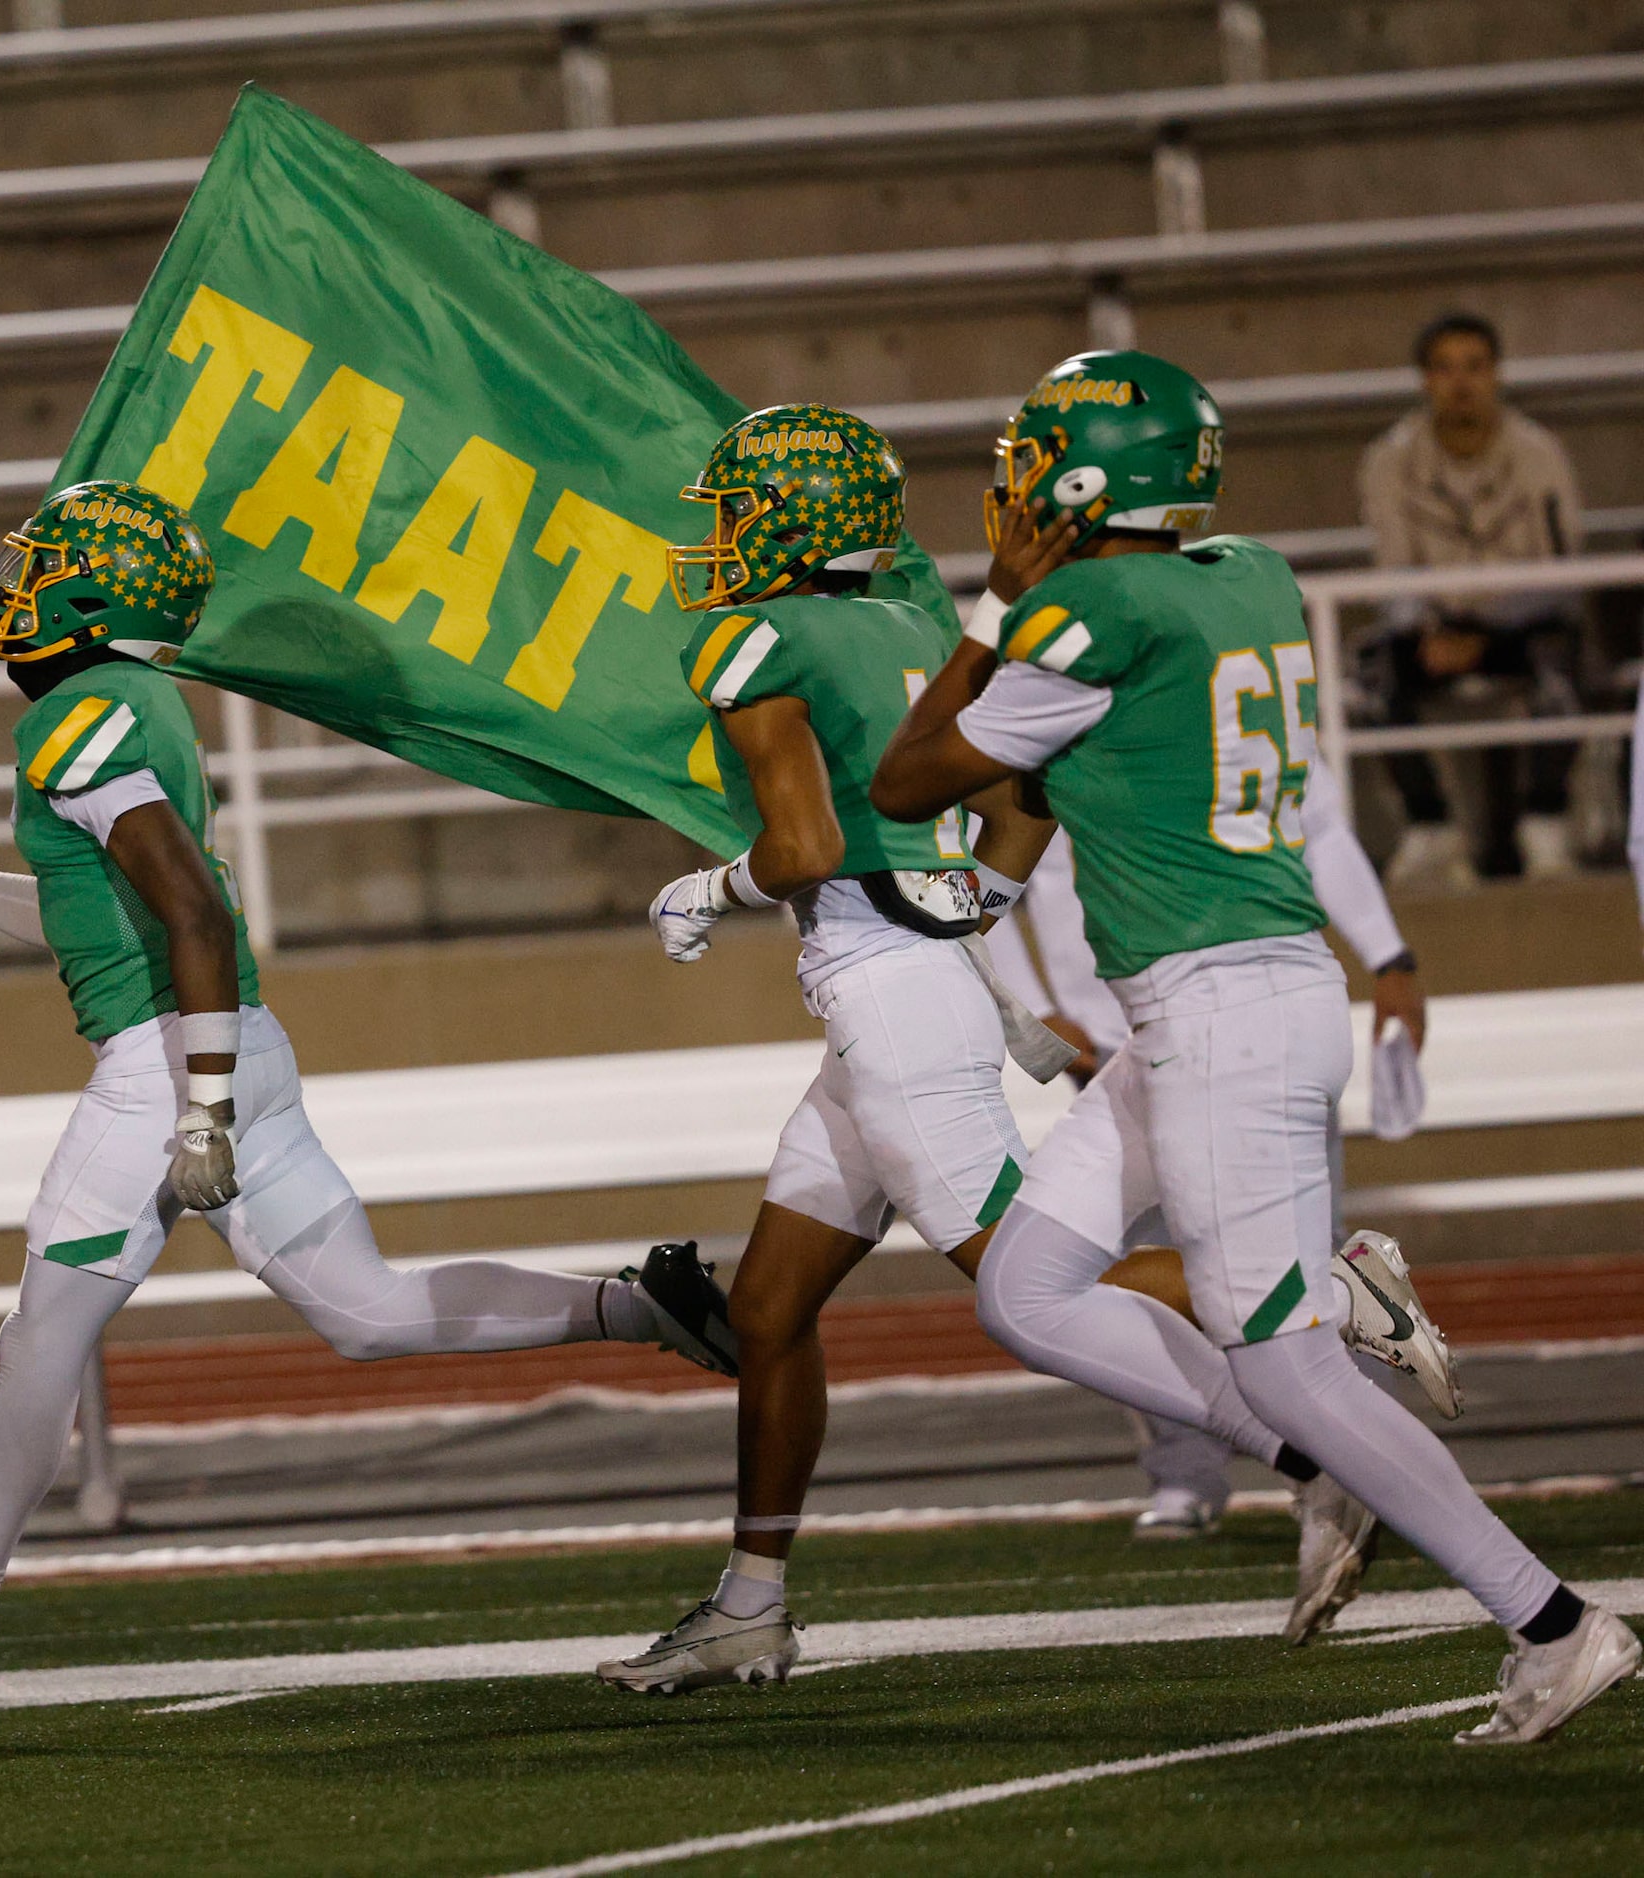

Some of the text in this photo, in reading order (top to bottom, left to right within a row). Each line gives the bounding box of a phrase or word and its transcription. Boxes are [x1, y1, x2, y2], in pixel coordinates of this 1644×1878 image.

[736, 426, 843, 461] Trojans
[1197, 427, 1224, 468] 65
[60, 493, 165, 539] Trojans
[136, 283, 674, 713] TAAT
[1208, 640, 1318, 854] 65
